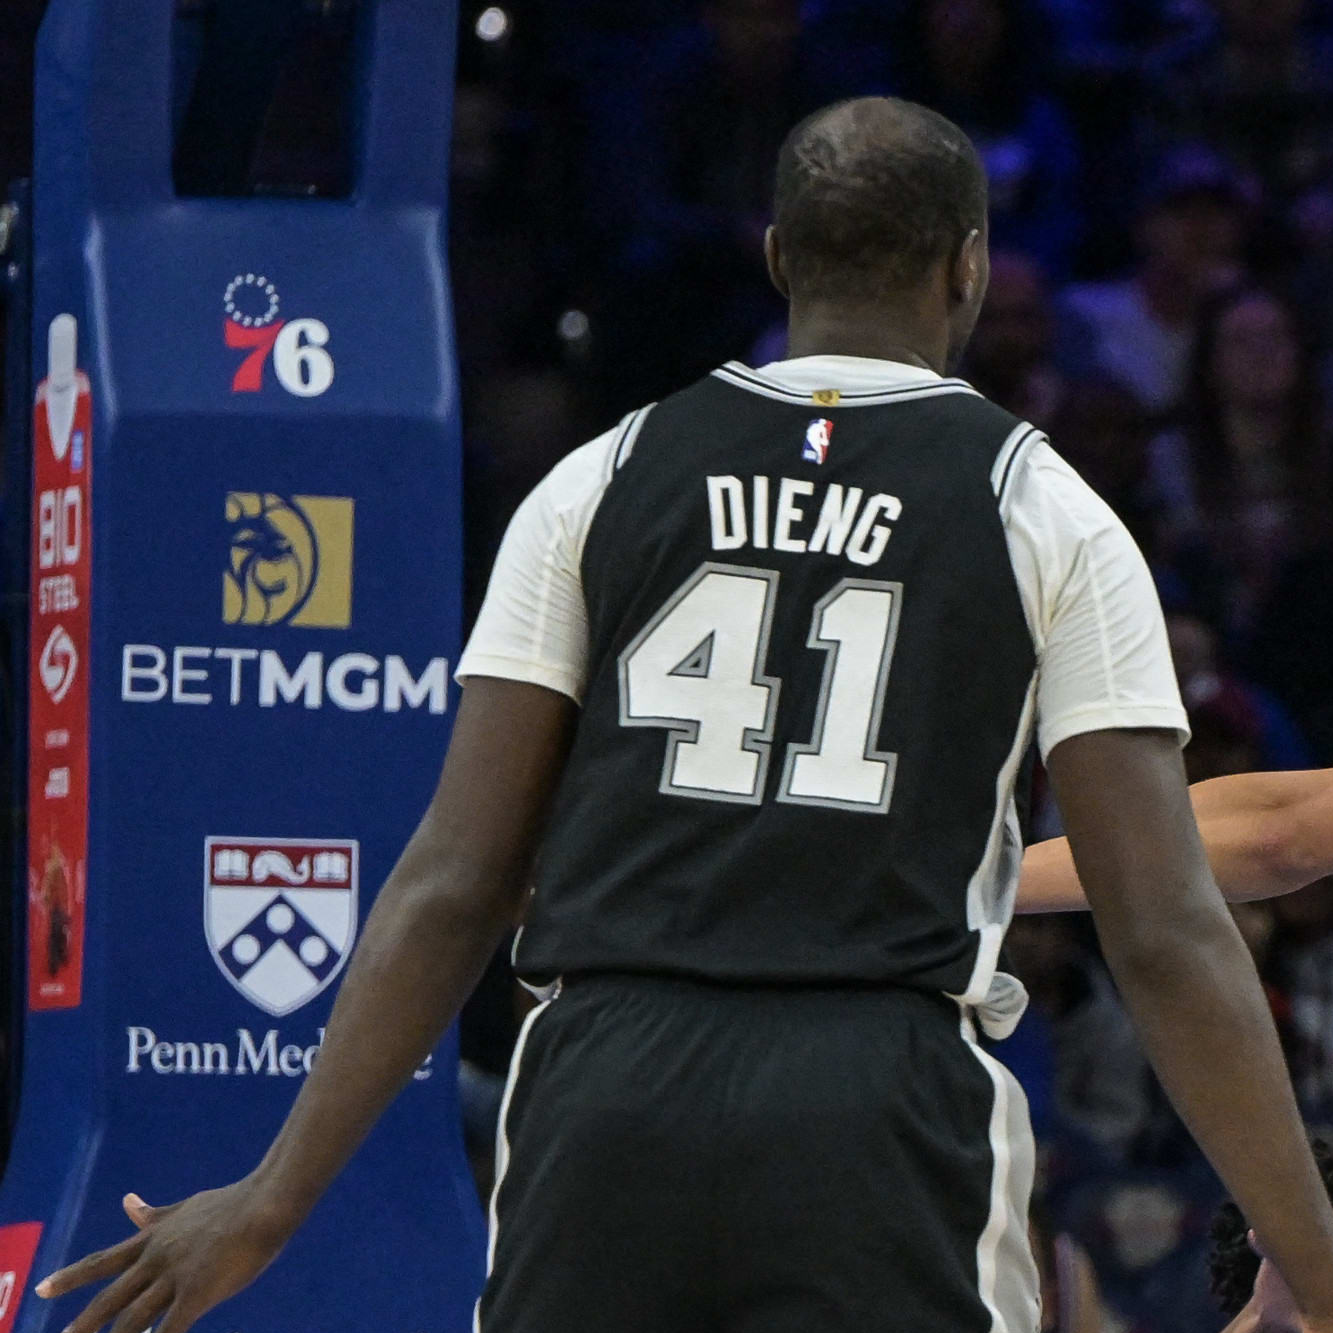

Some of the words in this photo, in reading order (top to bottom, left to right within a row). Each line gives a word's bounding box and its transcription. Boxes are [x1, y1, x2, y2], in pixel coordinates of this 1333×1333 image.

[223, 318, 334, 397] 76
[706, 475, 902, 566] DIENG
[121, 643, 449, 715] BETMGM
[617, 561, 904, 814] 41
[125, 1026, 229, 1074] Penn
